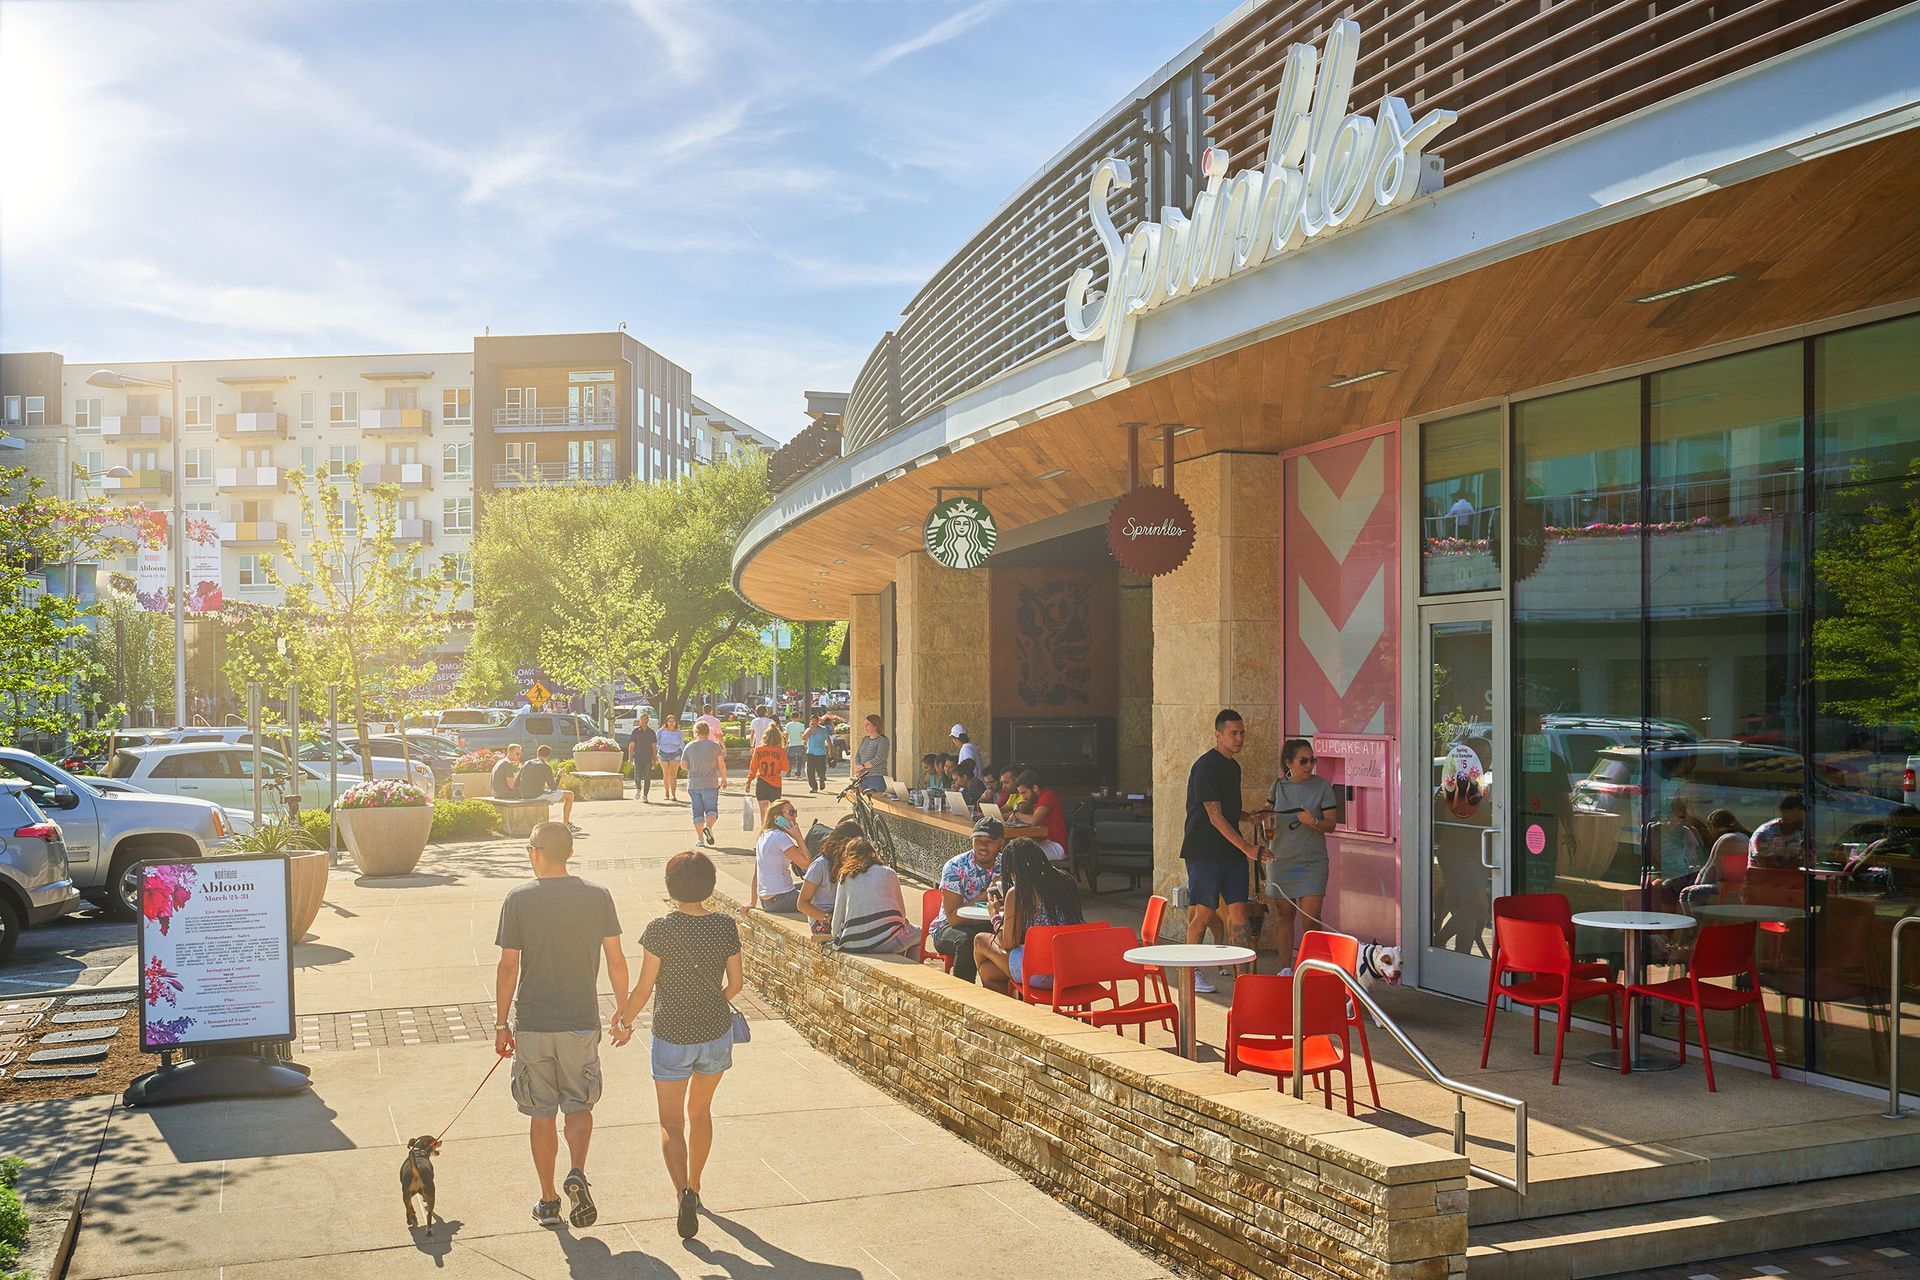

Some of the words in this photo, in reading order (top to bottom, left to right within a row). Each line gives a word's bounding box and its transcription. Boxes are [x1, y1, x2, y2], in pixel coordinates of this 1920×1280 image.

[1064, 18, 1458, 380] Sprinkles
[1122, 516, 1187, 541] Sprinkles
[1314, 739, 1360, 754] CUPCAKE
[1362, 741, 1385, 755] ATM
[761, 761, 775, 776] 91
[199, 881, 255, 894] Abloom
[204, 894, 228, 902] March
